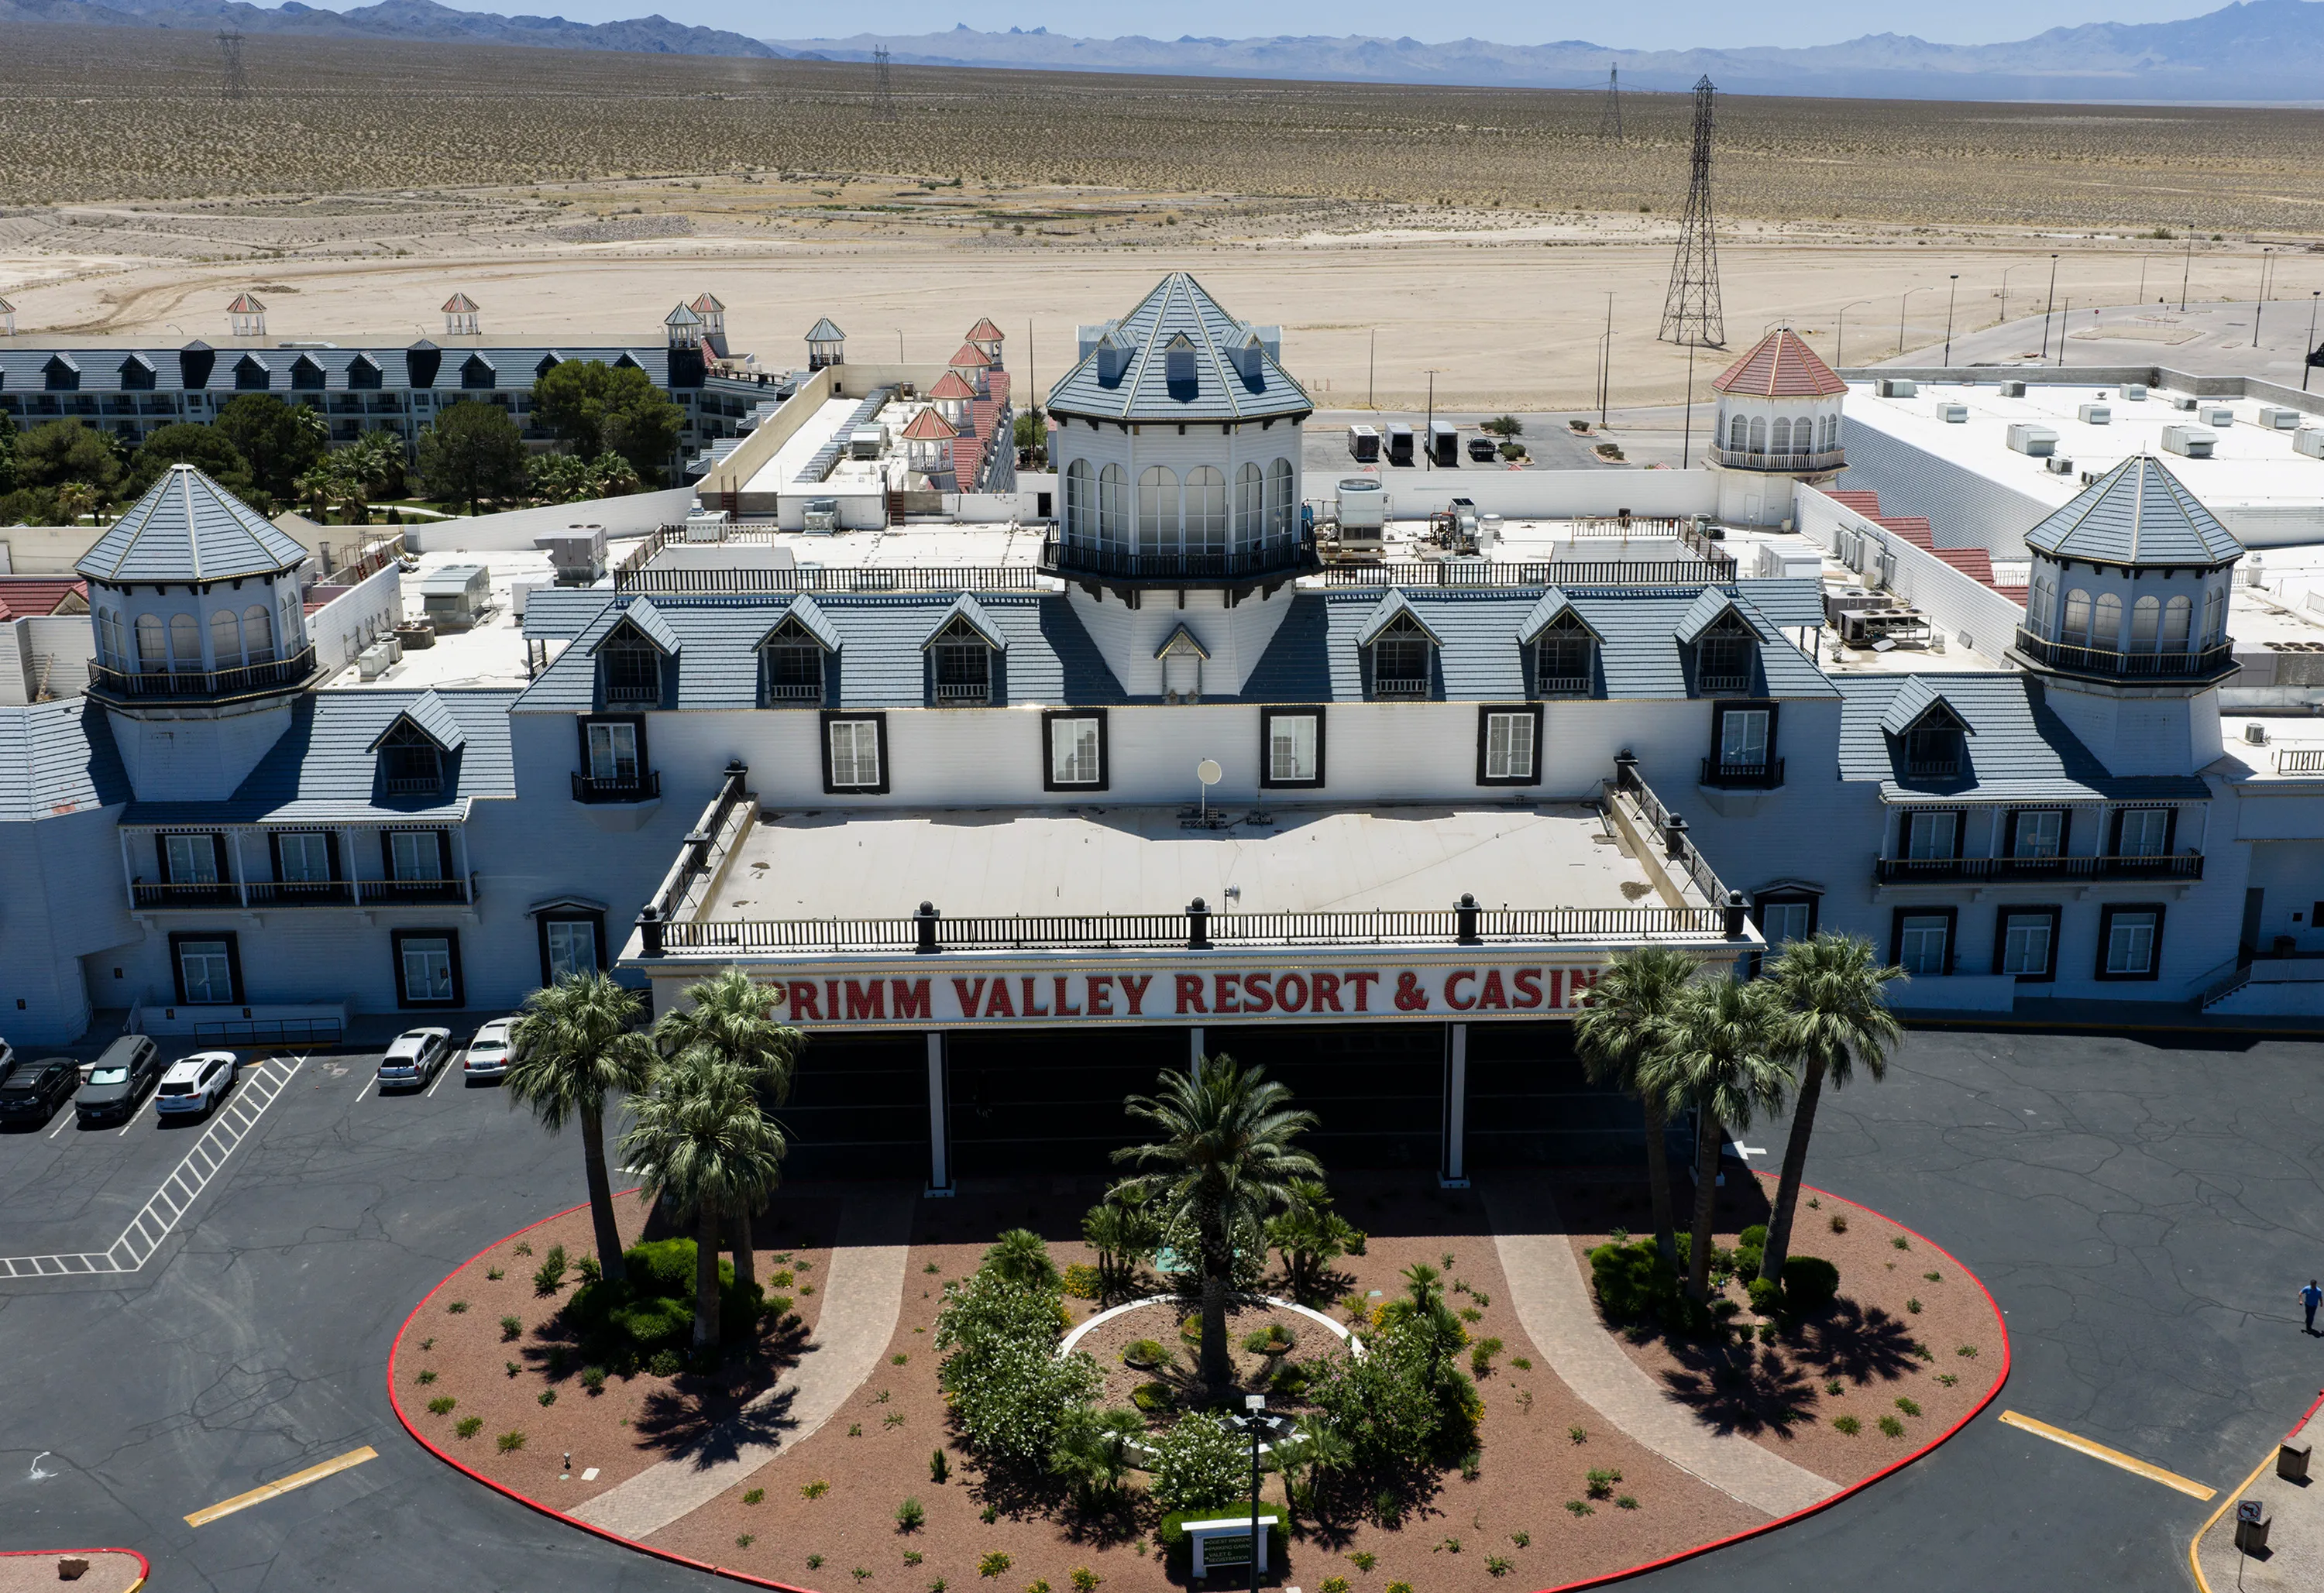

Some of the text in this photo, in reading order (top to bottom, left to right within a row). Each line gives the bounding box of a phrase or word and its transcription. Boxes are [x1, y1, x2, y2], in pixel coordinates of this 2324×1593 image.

[951, 973, 1153, 1018] VALLEY
[1174, 970, 1380, 1015] RESORT
[1394, 970, 1429, 1011] &
[1444, 967, 1625, 1011] CASIN
